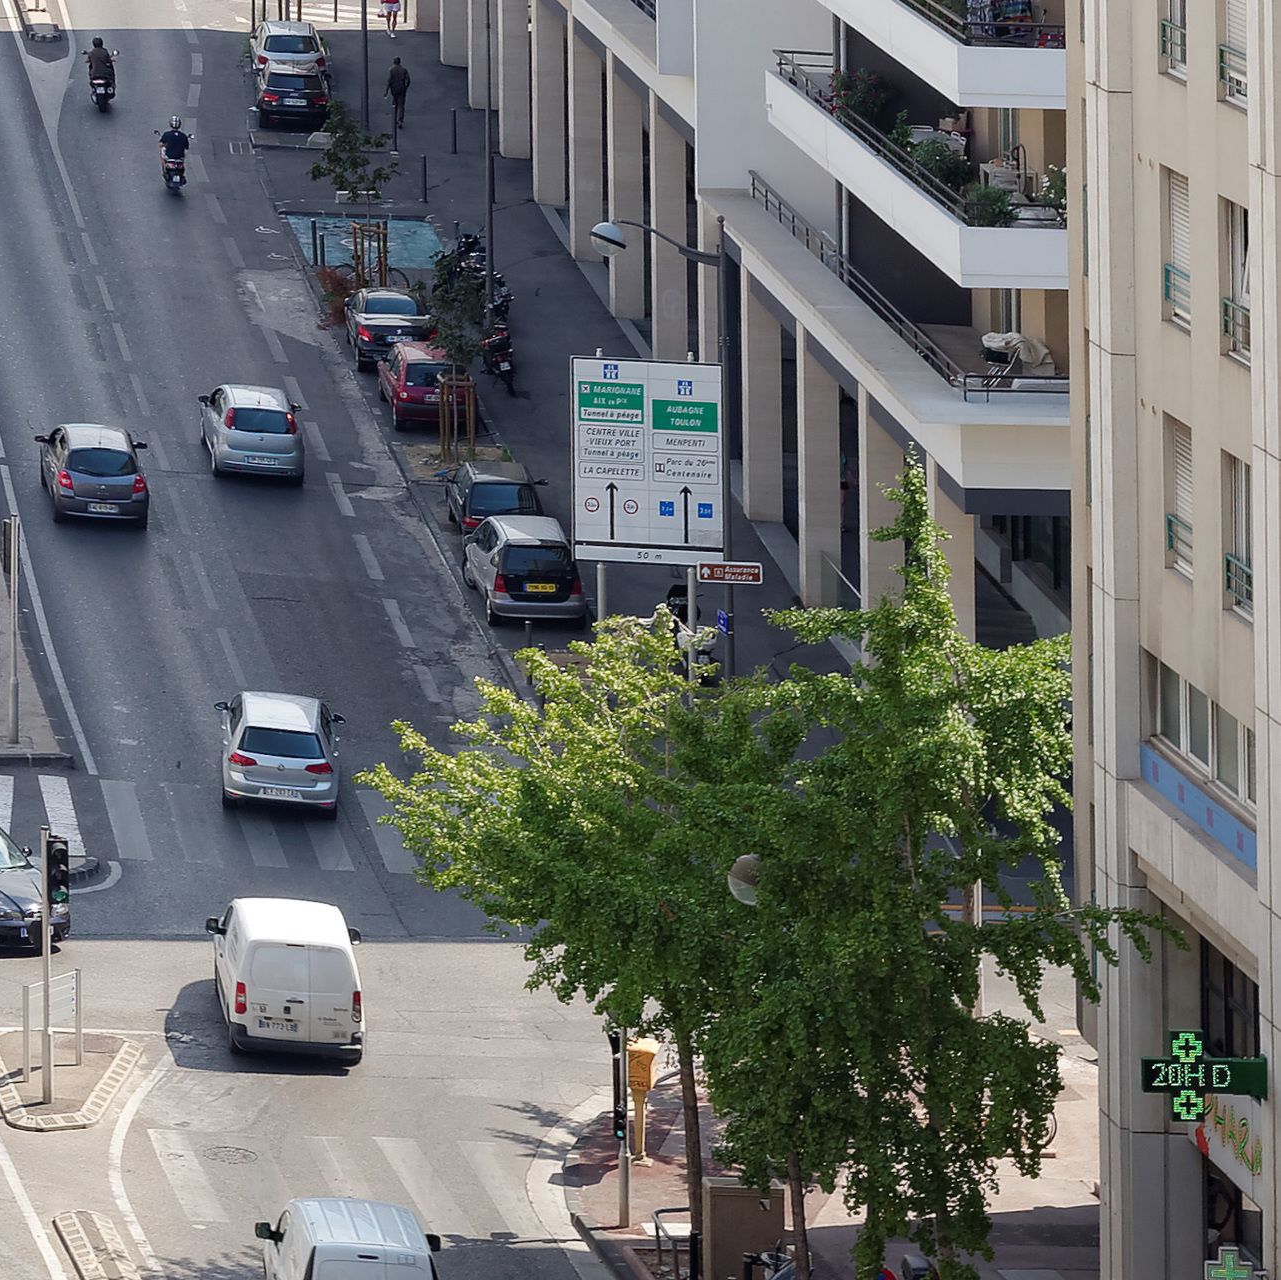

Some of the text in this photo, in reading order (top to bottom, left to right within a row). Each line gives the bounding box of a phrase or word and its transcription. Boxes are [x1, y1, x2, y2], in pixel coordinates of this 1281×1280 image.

[593, 386, 641, 395] MARIGNANE
[583, 409, 608, 417] Tunnel
[616, 412, 639, 420] péage
[666, 406, 704, 414] AUBAGNE
[670, 418, 702, 426] TOULON
[586, 428, 616, 436] CENTRE
[666, 438, 706, 446] MENPENTI
[584, 448, 608, 456] Tunnel
[617, 451, 639, 459] péage
[685, 458, 693, 466] du
[596, 467, 640, 476] CAPELETTE
[666, 469, 712, 478] Centenaire
[1213, 1065, 1230, 1087] D
